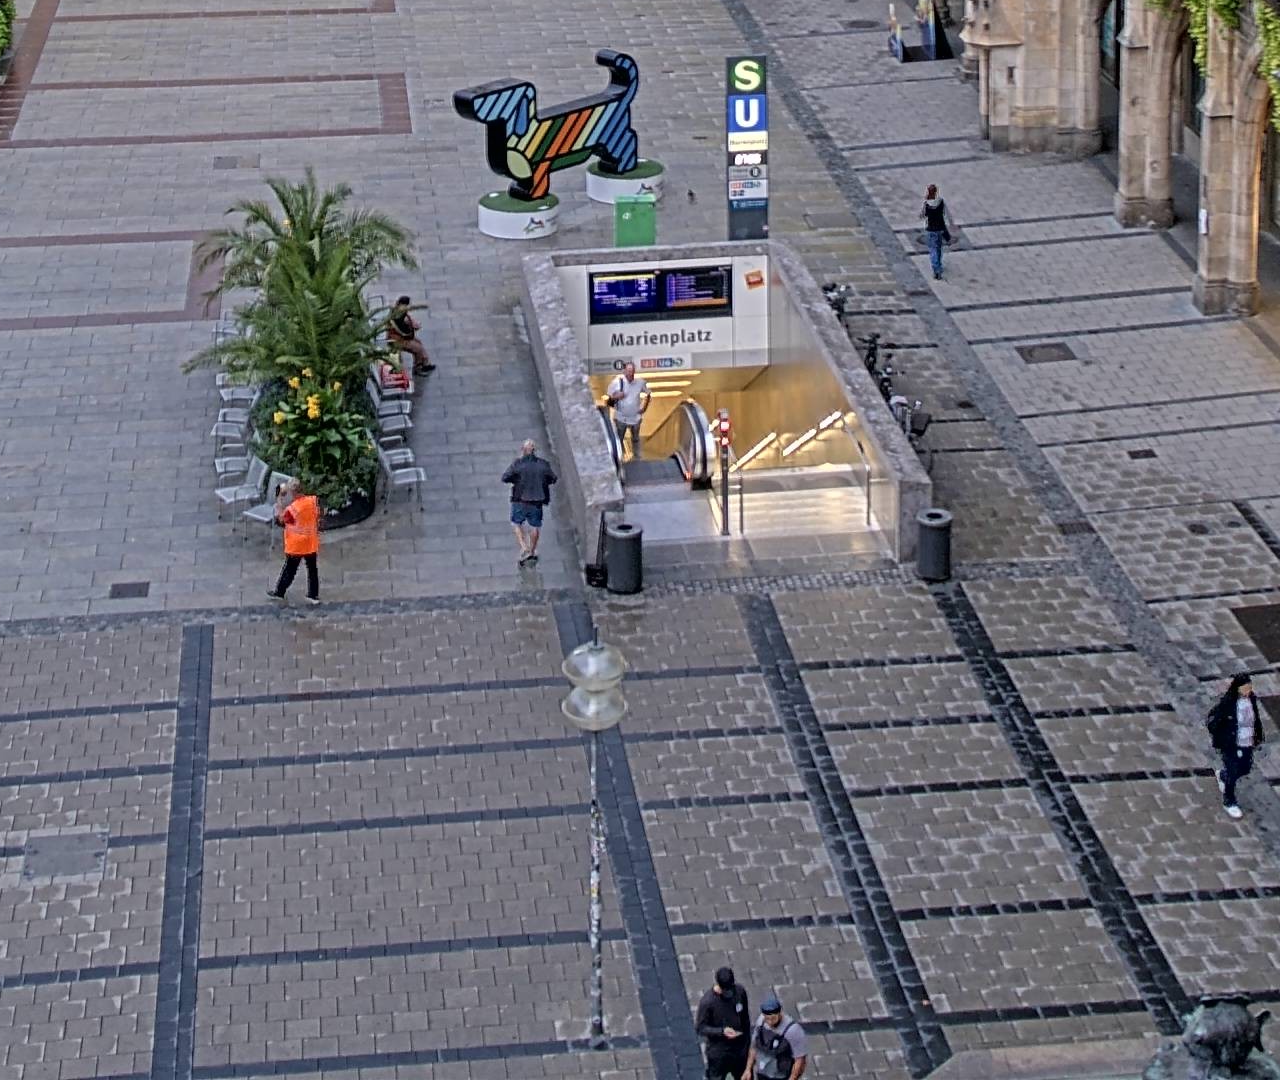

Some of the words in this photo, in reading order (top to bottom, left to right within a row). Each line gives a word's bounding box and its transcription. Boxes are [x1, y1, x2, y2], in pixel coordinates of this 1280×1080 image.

[734, 60, 761, 91] S
[734, 98, 760, 128] U
[610, 328, 712, 348] Marienplatz
